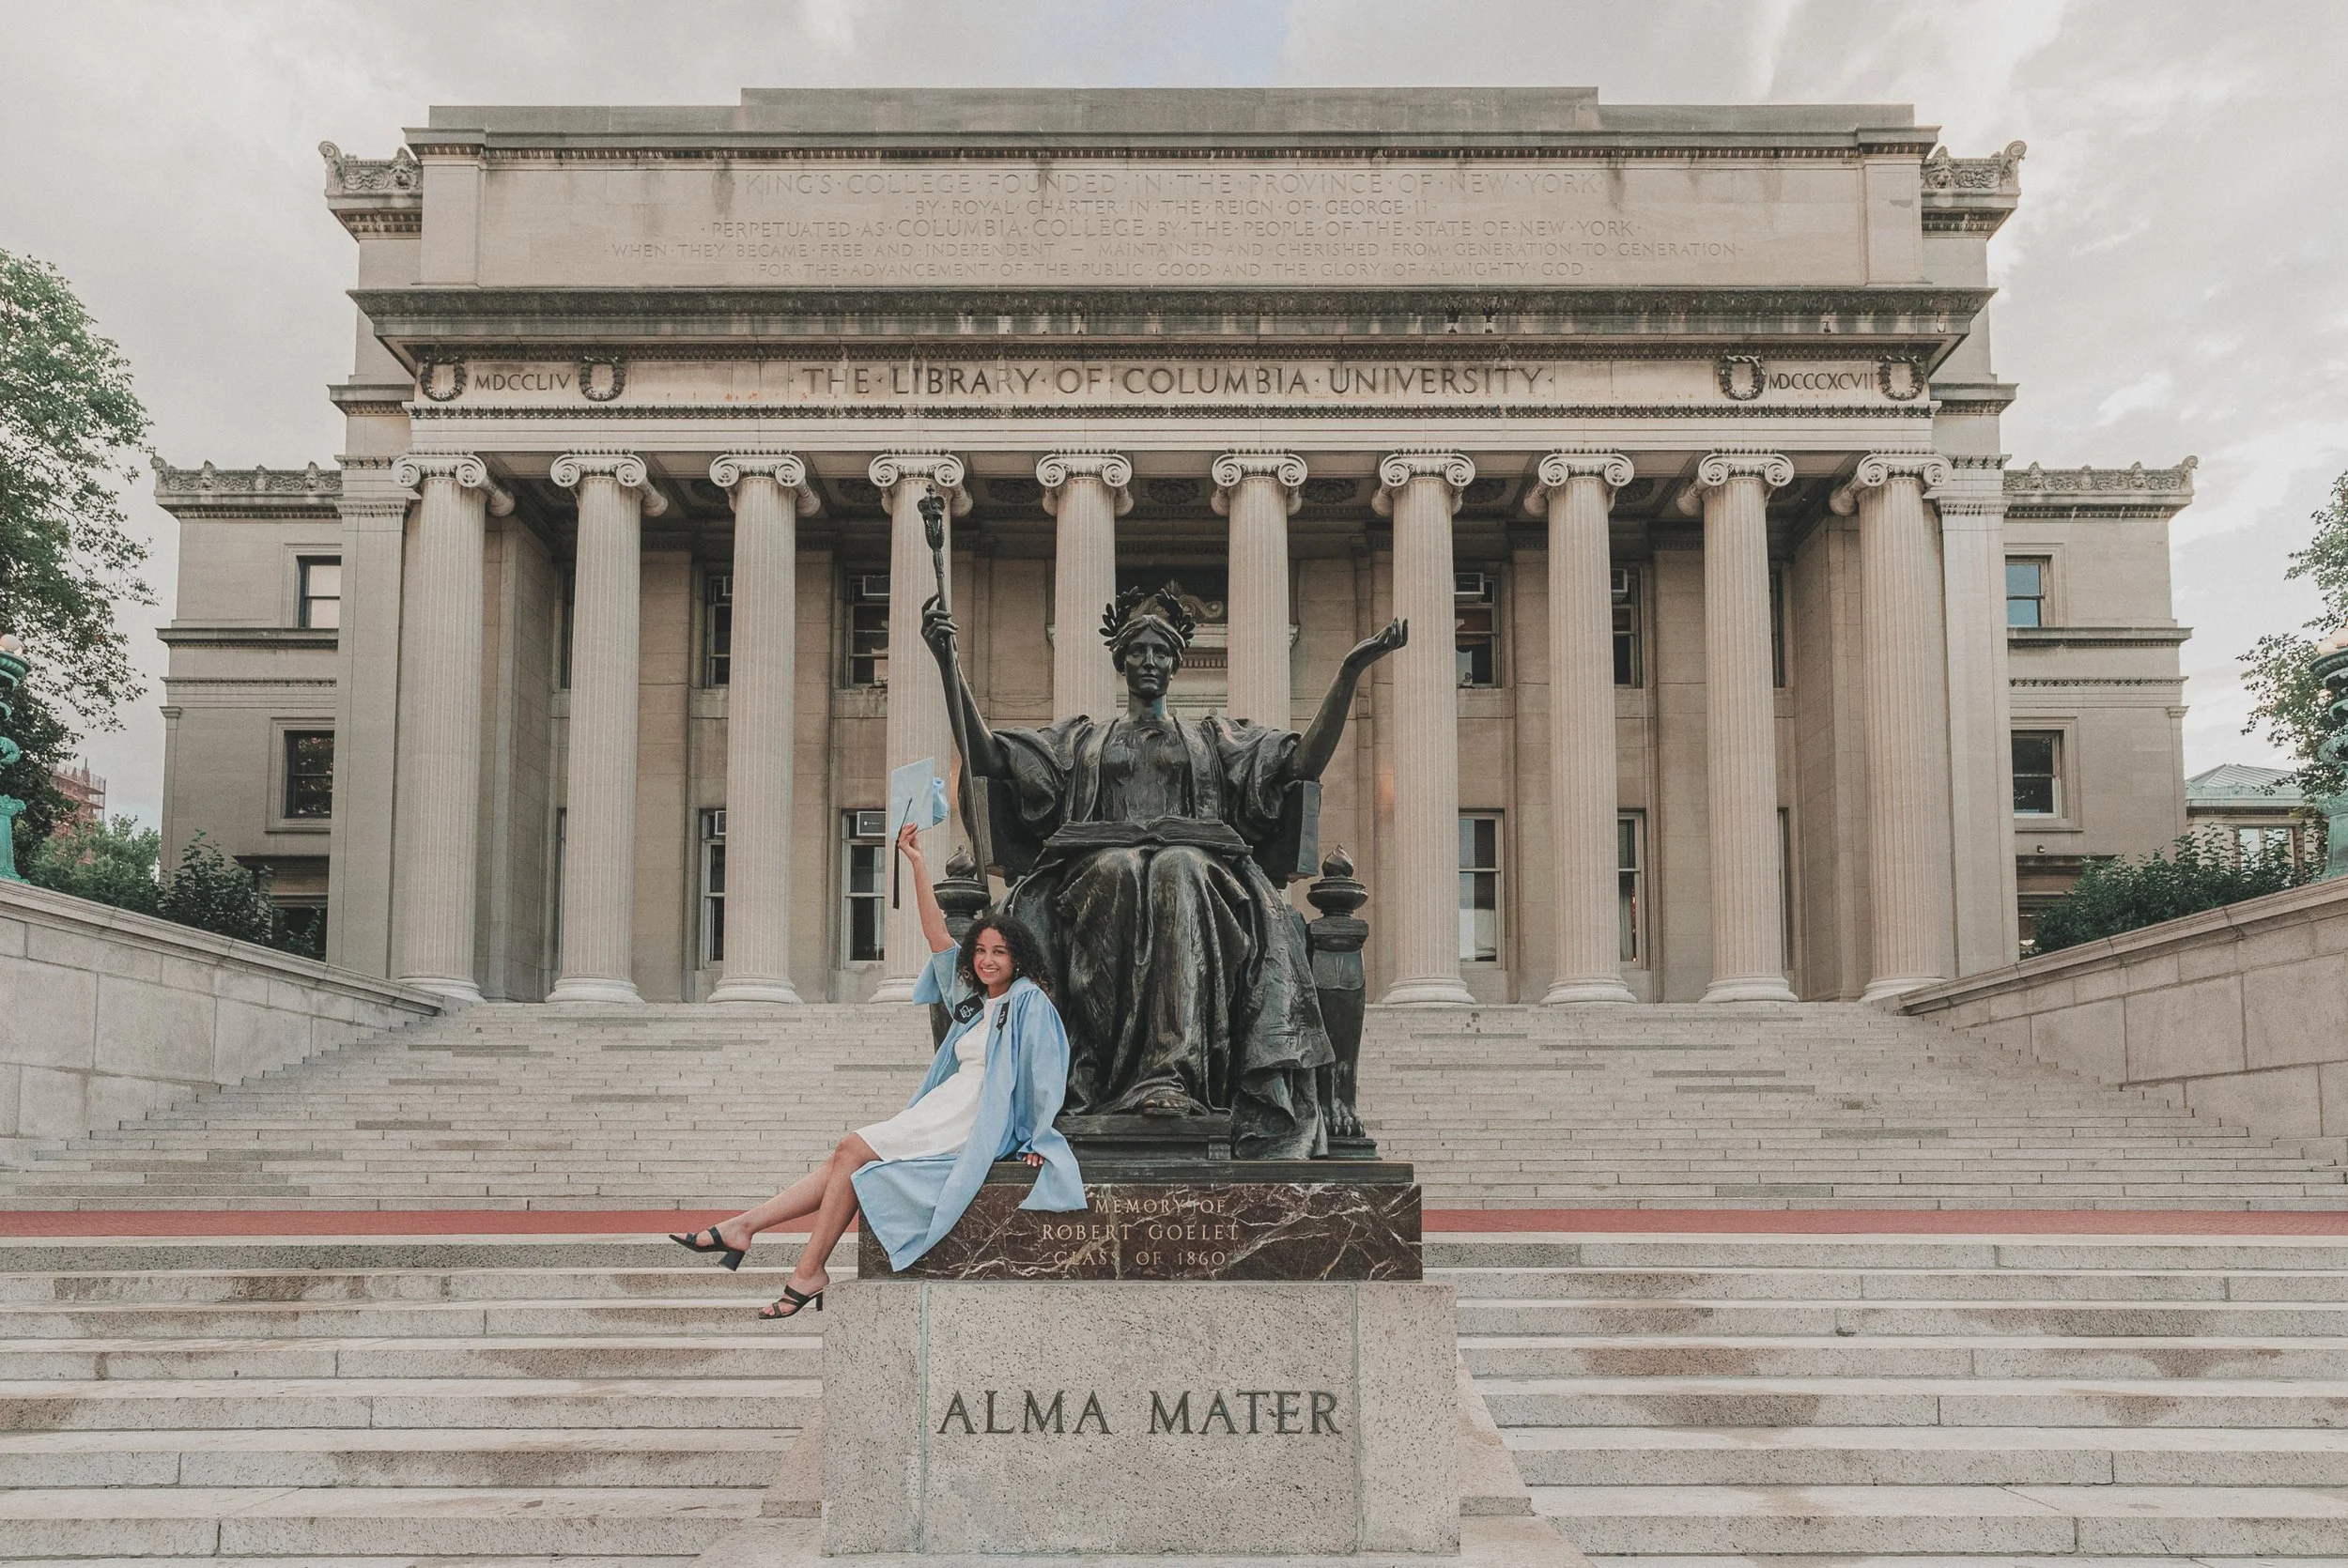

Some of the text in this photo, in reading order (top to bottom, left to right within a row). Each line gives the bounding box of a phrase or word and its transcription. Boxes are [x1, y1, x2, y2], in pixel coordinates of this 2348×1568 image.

[747, 175, 1599, 194] KING'S COLLEGE FOUNDED IN THE PROVINCE OF NEW YORK
[916, 200, 1428, 215] BY ROYAL CHARTER IN THE REIGN OF GEORGE II
[712, 220, 1634, 237] PERPETUATED AS COLUMBIA COLLEGE BY THE PEOPLE OF THE STATE OF NEW YORK
[611, 244, 1737, 257] WHEN THEY BECAME FREE AND INDEPENDENT MAINTAINED AND CHERISHED FROM GENERATION TO GENERATION
[758, 264, 1583, 277] FOR THE ADVANCEMENT OF THE PUBLIC GOOD AND THE GLORY OF ALMIGHTY GOD
[474, 374, 569, 391] MDCCLIV
[802, 368, 1544, 394] THE LIBRARY OF COLUMBIA UNIVERSITY
[1769, 373, 1875, 391] MDCCCXCVII
[1094, 1199, 1226, 1214] MEMORY OF
[1043, 1224, 1239, 1240] ROBERT GOELET
[1054, 1252, 1226, 1266] CLASS OF 1860
[937, 1390, 1343, 1436] ALMA MATER
